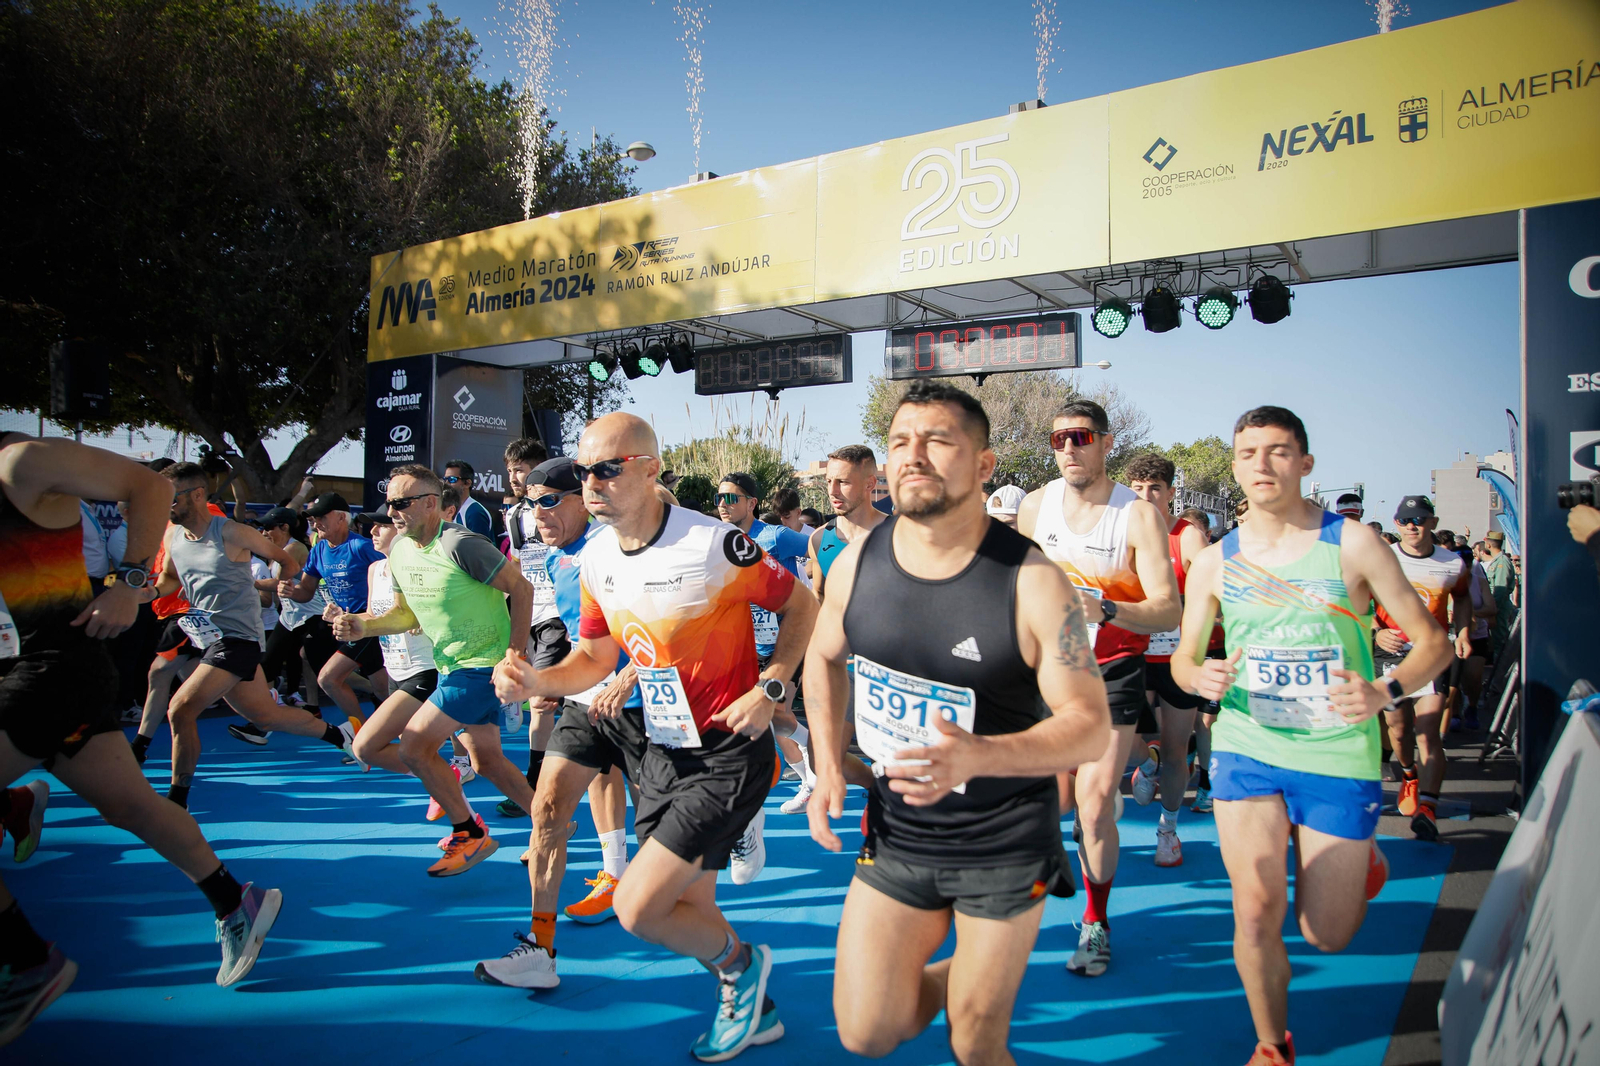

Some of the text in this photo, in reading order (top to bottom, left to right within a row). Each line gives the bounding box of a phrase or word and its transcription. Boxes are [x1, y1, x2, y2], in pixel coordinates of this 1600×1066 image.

[1458, 59, 1600, 112] ALMERÍA
[1457, 104, 1530, 130] CIUDAD
[1266, 159, 1289, 171] 2020
[1142, 163, 1235, 188] COOPERACIÓN
[900, 132, 1021, 242] 25
[1142, 185, 1173, 200] 2005
[642, 247, 675, 259] SERIES
[645, 237, 679, 250] RFEA
[899, 232, 1020, 274] EDICIÓN
[661, 252, 696, 263] RUNNING
[467, 250, 597, 289] Medio Maratón
[607, 255, 771, 294] RAMÓN RUIZ ANDÚJAR
[438, 275, 456, 295] 25
[465, 272, 597, 315] Almería 2024
[376, 392, 422, 412] cajamar
[452, 412, 507, 427] COOPERACIÓN
[452, 421, 472, 431] 2005
[384, 444, 415, 454] HYUNDAI
[409, 572, 424, 586] MTB
[526, 570, 551, 583] 579
[643, 585, 682, 594] SALINAS CAR
[1260, 622, 1337, 639] SAKATA
[1258, 662, 1330, 687] 5881
[646, 683, 677, 705] 29
[885, 716, 930, 738] RODOLFO
